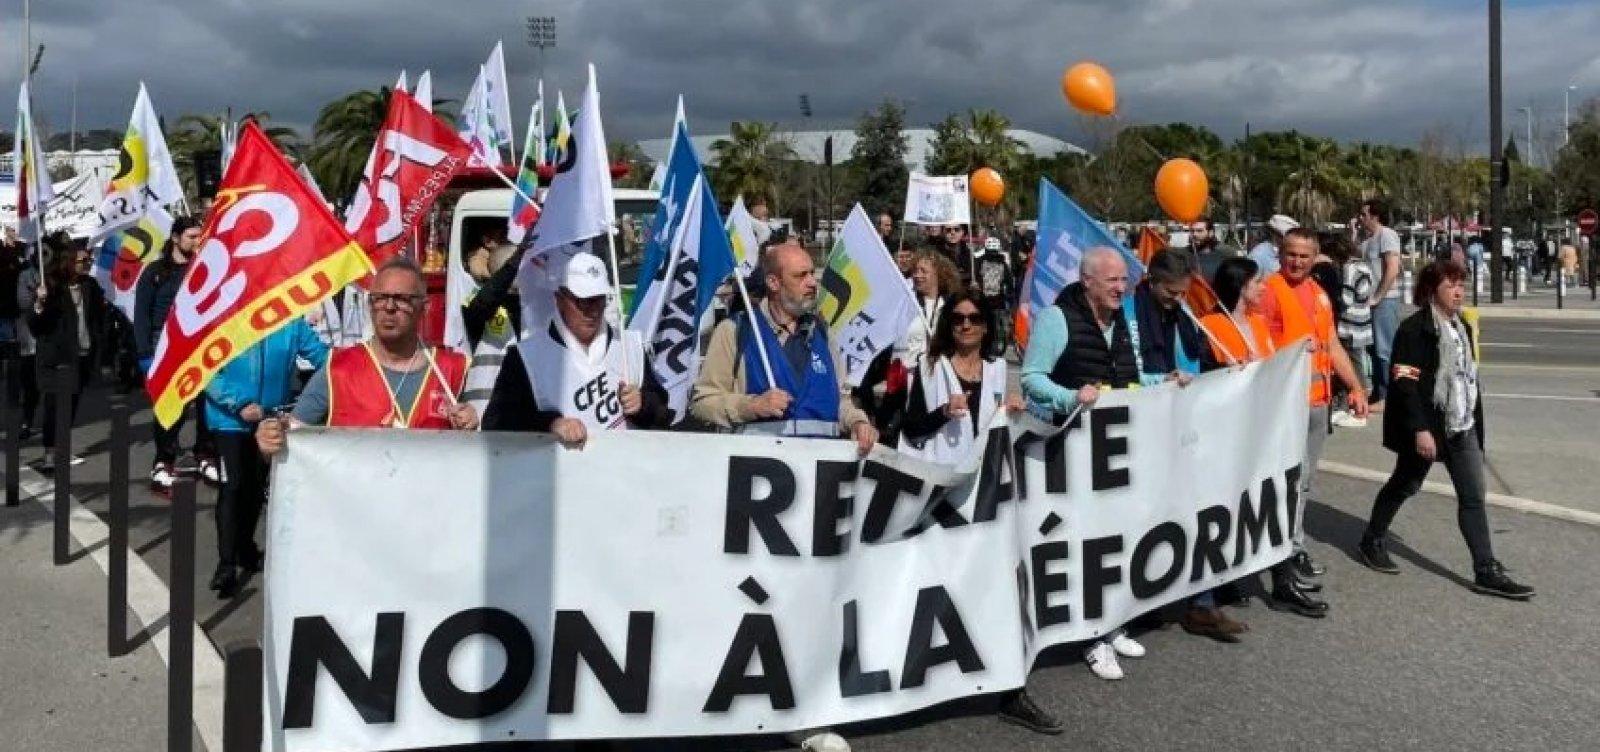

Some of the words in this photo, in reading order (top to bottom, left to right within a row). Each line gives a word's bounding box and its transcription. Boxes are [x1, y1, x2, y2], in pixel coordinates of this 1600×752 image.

[574, 370, 608, 412] CFE
[282, 606, 656, 730] NON
[701, 575, 797, 713] À
[838, 584, 987, 698] LA
